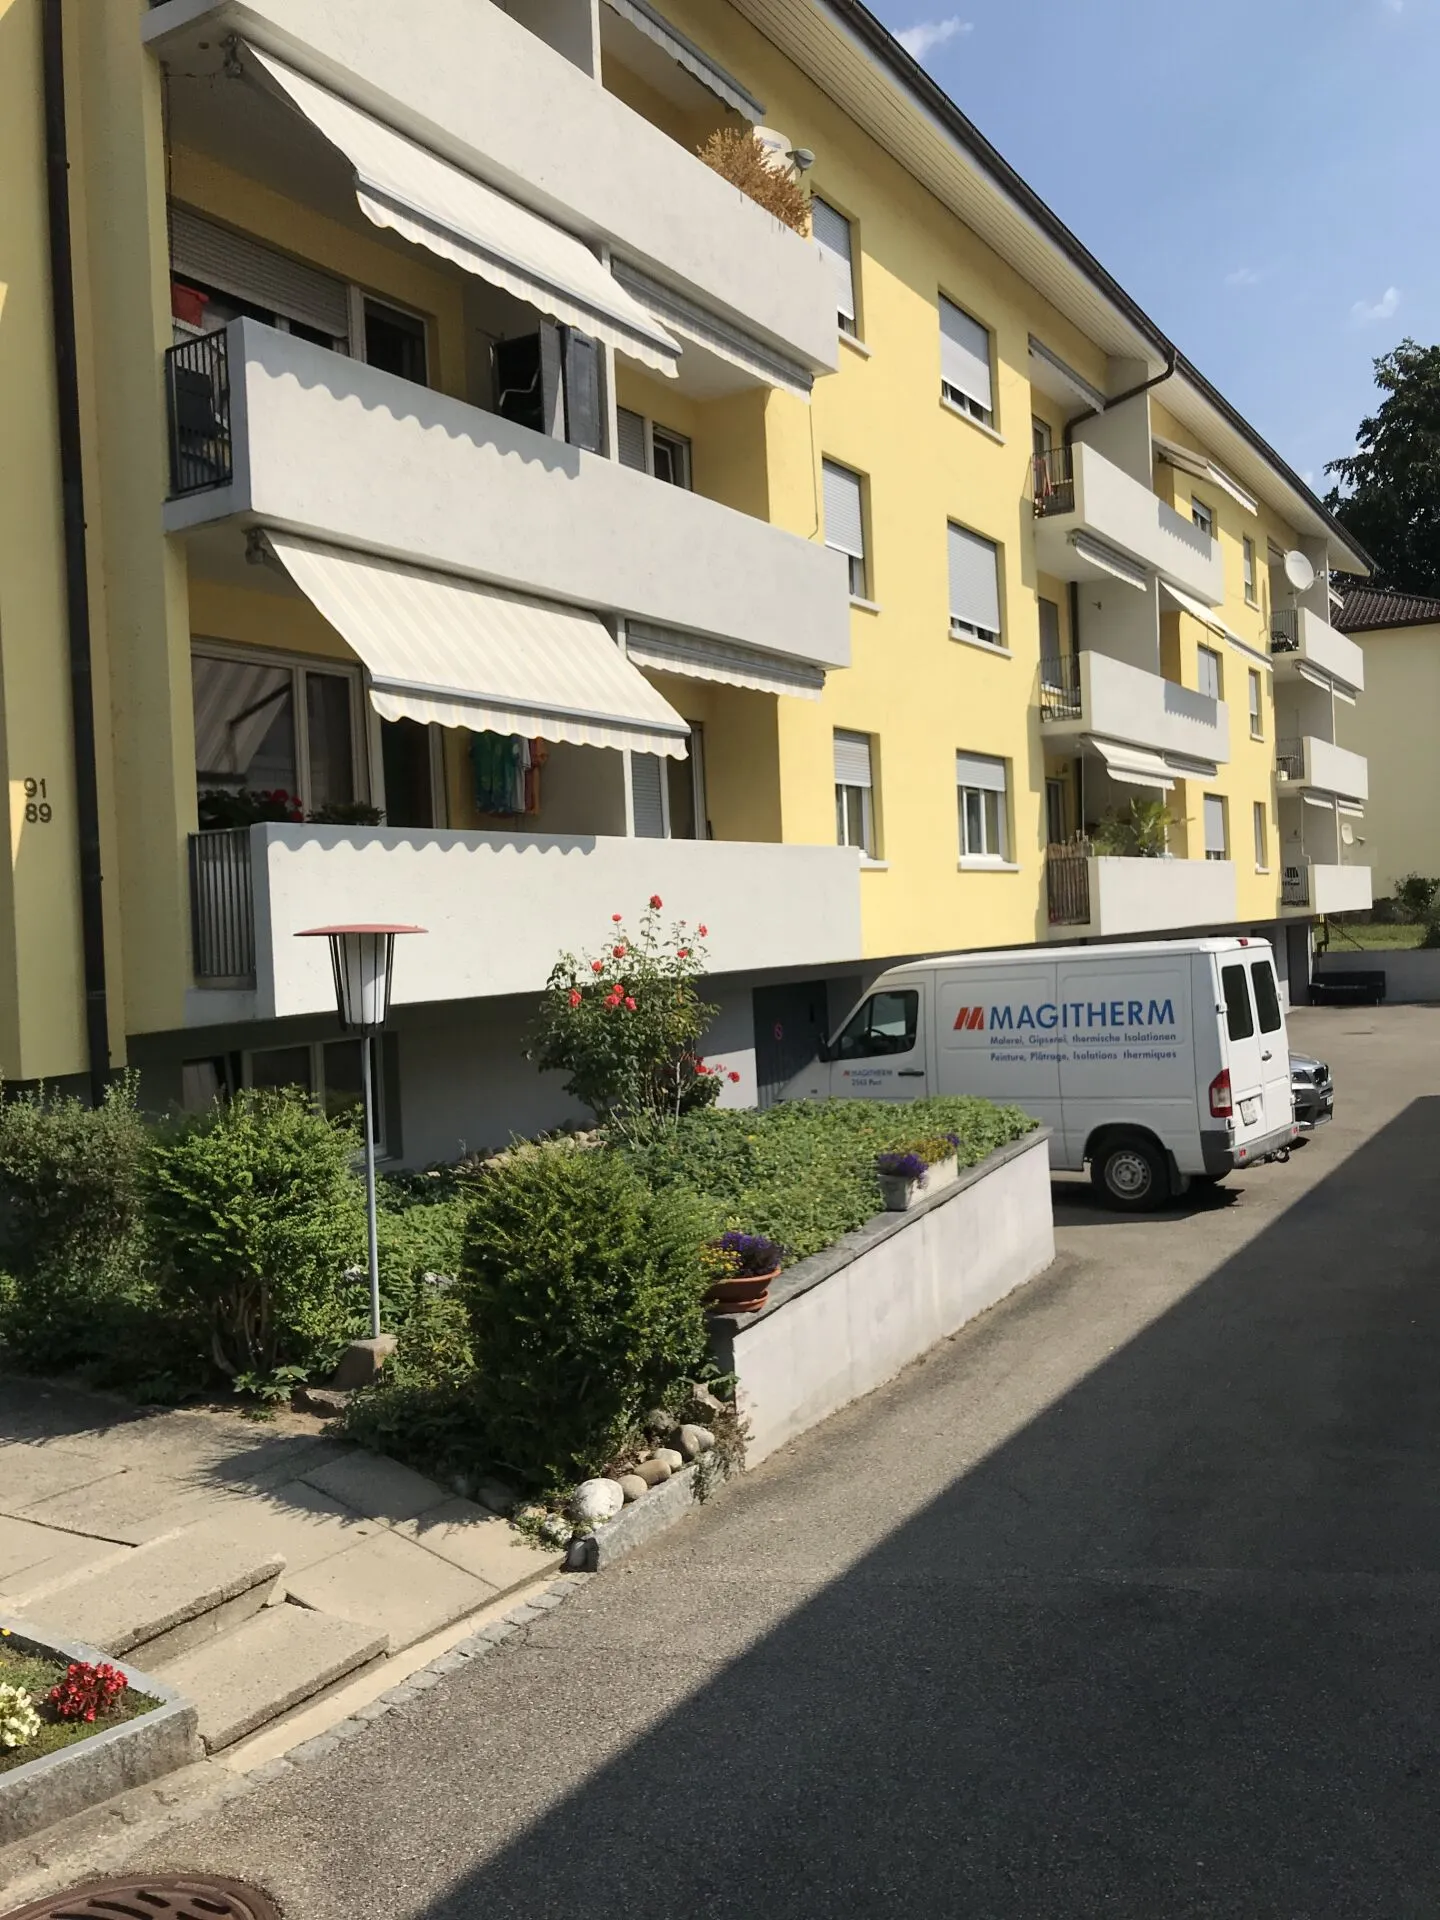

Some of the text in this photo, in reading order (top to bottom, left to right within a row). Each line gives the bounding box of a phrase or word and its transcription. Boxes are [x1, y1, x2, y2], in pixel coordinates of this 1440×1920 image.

[24, 777, 46, 798] 91
[26, 803, 52, 824] 89
[989, 999, 1175, 1030] MAGITHERM
[990, 1036, 1024, 1046] Malerei,
[1072, 1032, 1120, 1043] thermische
[1124, 1031, 1176, 1042] Isolationen
[990, 1053, 1026, 1062] Peinture,
[1073, 1050, 1118, 1060] Isolations
[1123, 1049, 1176, 1060] thermiques
